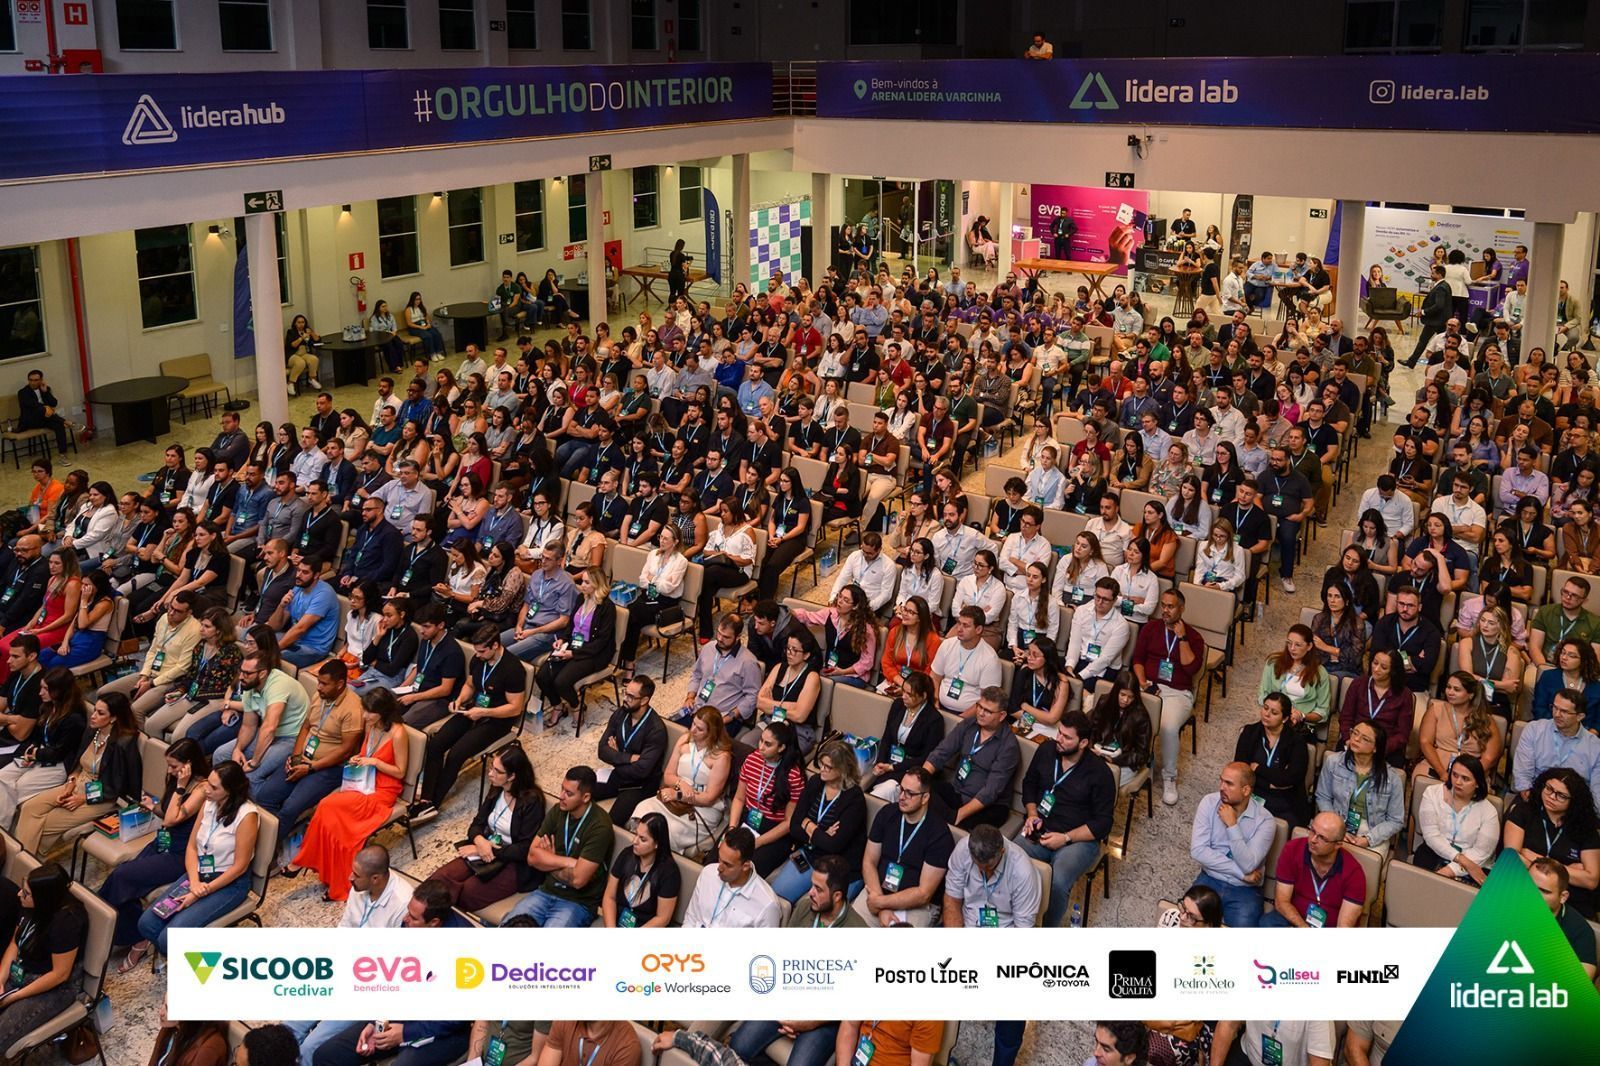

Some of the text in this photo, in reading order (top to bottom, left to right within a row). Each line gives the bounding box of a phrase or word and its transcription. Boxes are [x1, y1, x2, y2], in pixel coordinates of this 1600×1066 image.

[68, 6, 82, 22] H
[871, 78, 930, 89] Bem-vindos
[1125, 79, 1239, 103] lidera lab
[413, 76, 733, 123] #ORGULHODOINTERIOR
[871, 91, 1001, 102] ARENA LIDERA VARGINHA
[1401, 85, 1489, 100] lidera.lab
[181, 102, 286, 128] liderahub
[1038, 204, 1060, 216] eva
